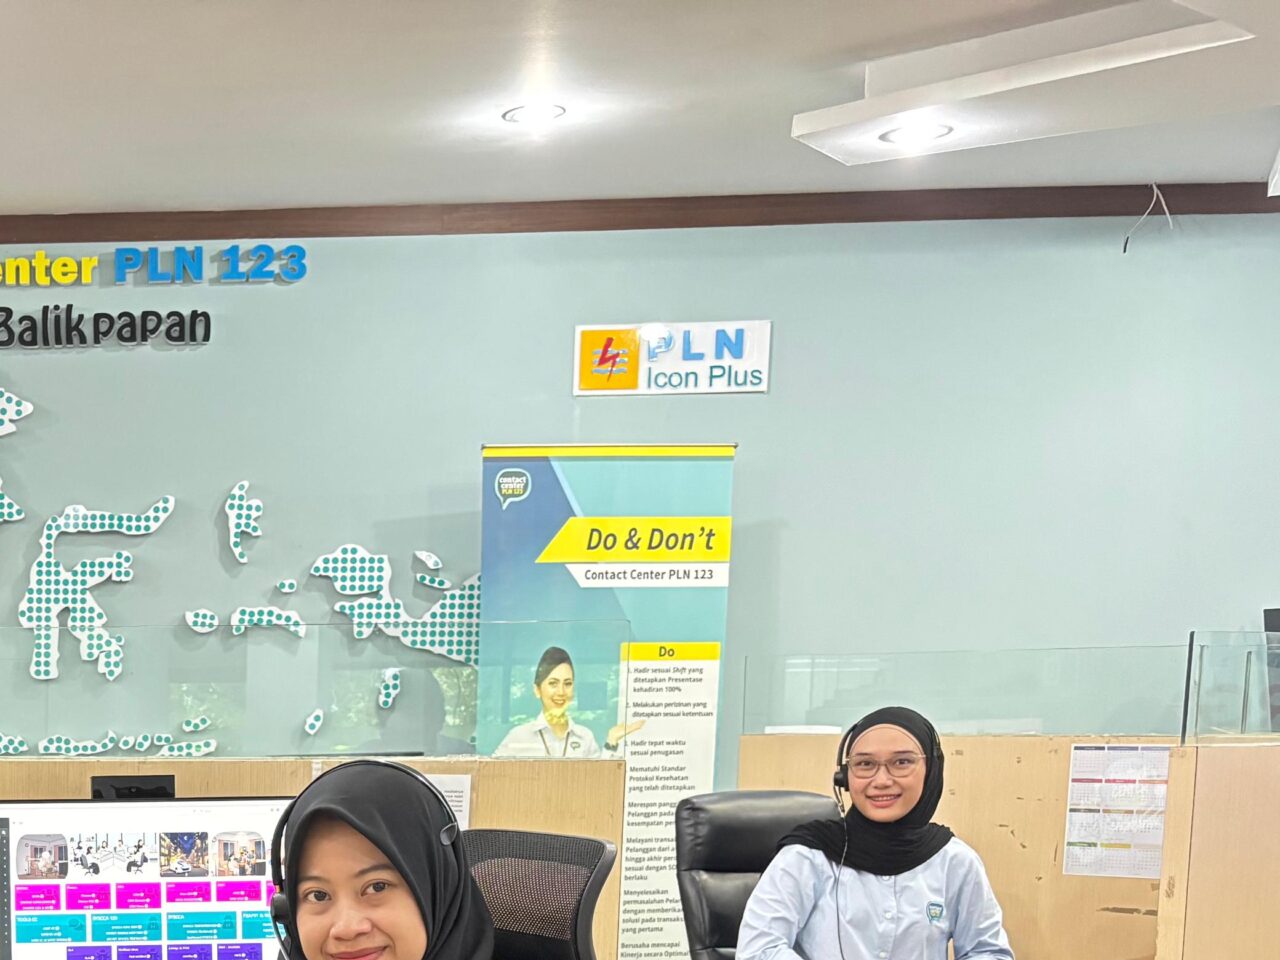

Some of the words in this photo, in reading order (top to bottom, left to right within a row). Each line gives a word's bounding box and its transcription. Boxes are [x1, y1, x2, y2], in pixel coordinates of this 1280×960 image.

[114, 246, 204, 285] PLN
[220, 244, 308, 283] 123
[647, 328, 745, 362] PLN
[647, 367, 699, 389] Icon
[708, 365, 763, 387] Plus
[586, 528, 617, 550] Do
[624, 528, 641, 550] &
[647, 526, 716, 550] Don't
[584, 569, 628, 580] Contact
[630, 569, 666, 580] Center
[669, 569, 690, 580] PLN
[694, 569, 713, 579] 123
[658, 646, 675, 657] Do
[672, 666, 687, 674] Shift
[688, 667, 704, 675] yang
[628, 785, 643, 793] yang
